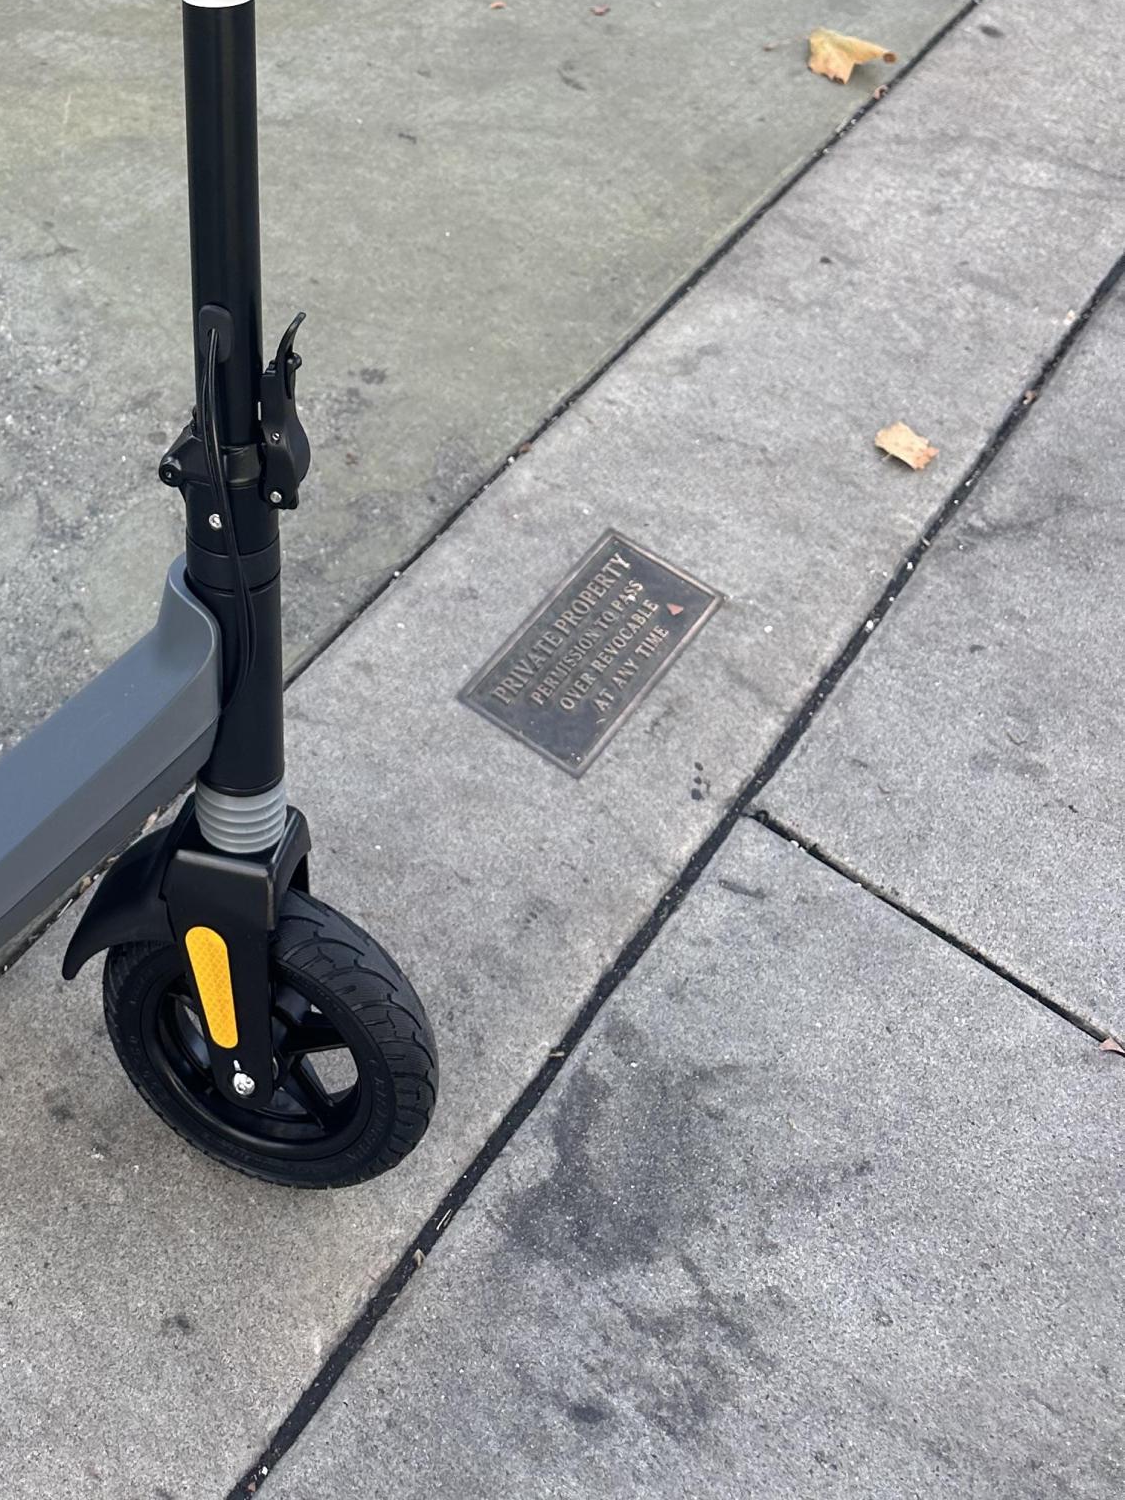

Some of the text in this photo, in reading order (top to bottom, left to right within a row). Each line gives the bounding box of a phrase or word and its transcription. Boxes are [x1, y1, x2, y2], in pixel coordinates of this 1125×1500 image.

[492, 552, 630, 704] PRIVATE PROPERTY
[530, 579, 643, 705] PERMISSION TO PASS
[559, 598, 658, 711] OVER REVOCABLE
[592, 624, 669, 713] AT ANY TIME
